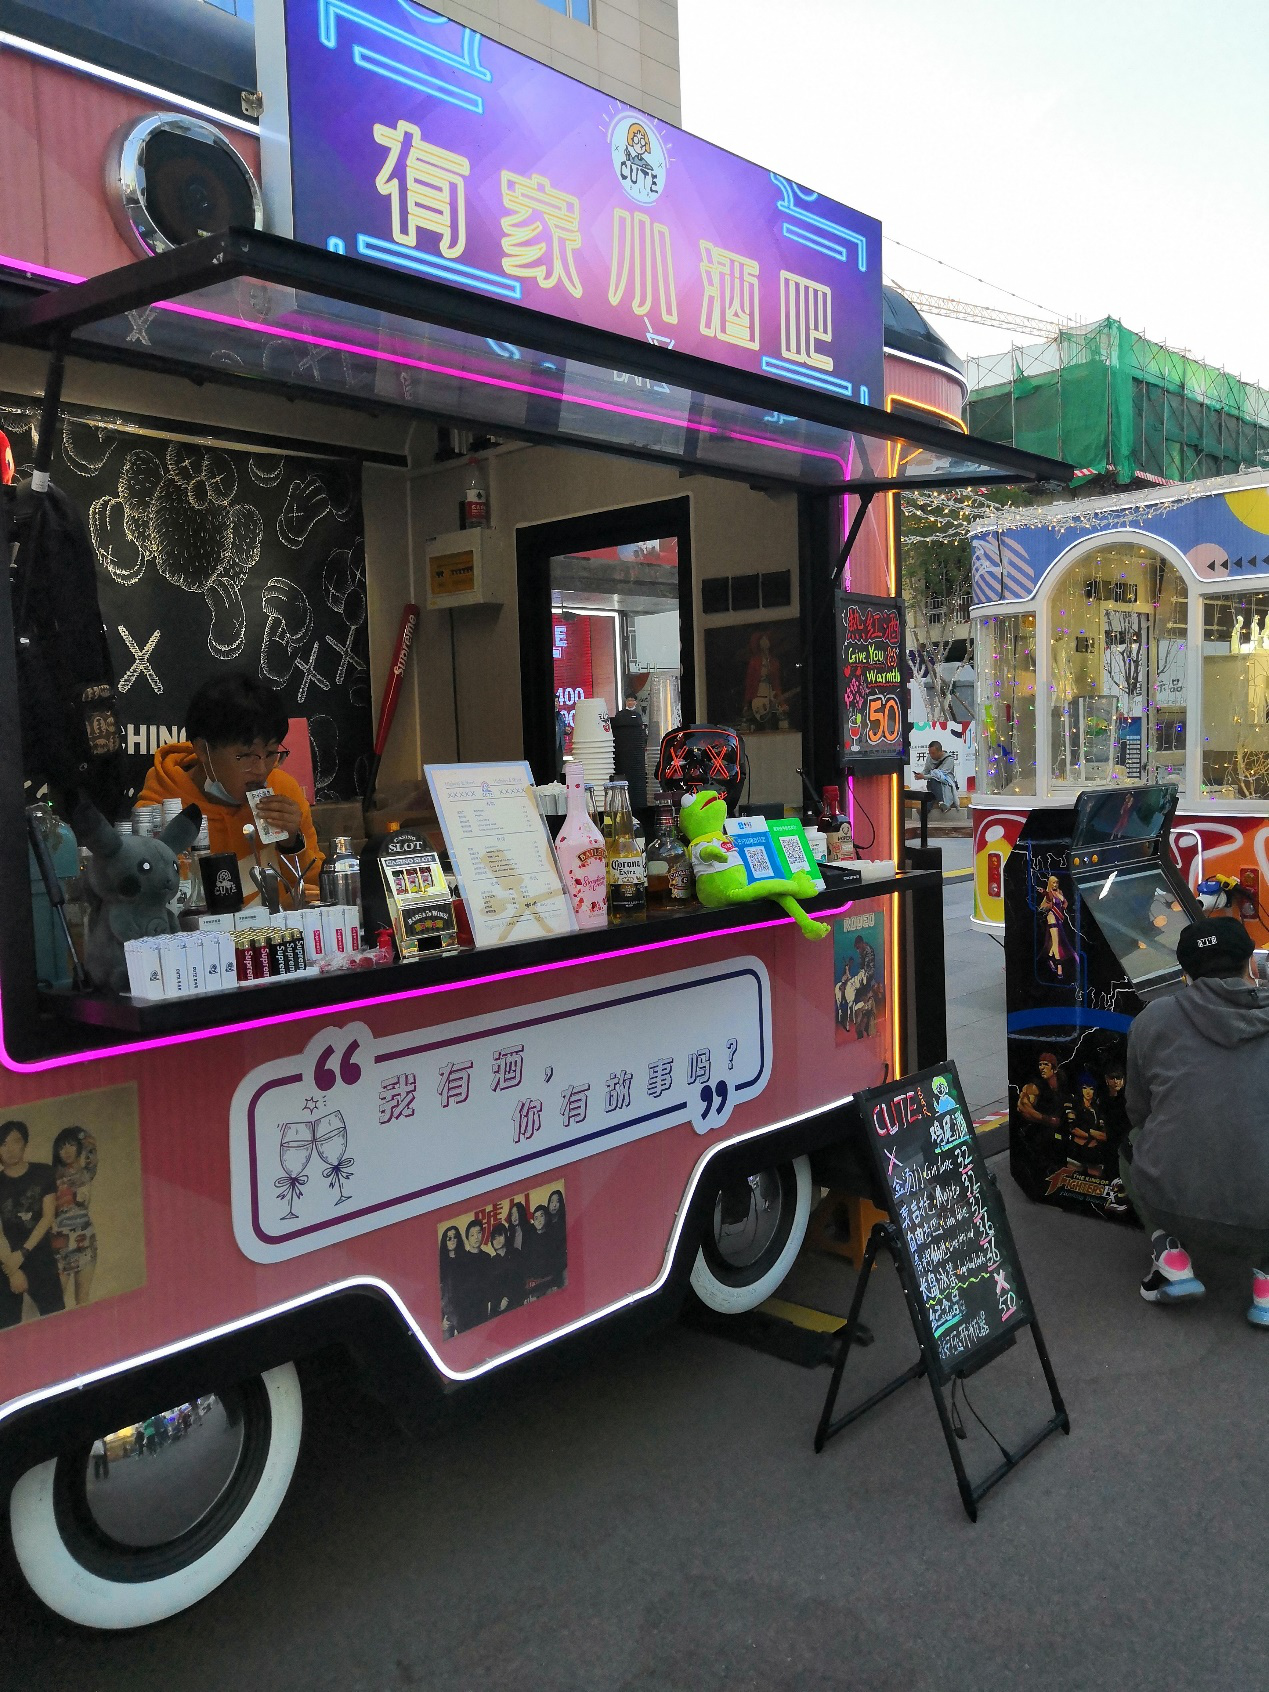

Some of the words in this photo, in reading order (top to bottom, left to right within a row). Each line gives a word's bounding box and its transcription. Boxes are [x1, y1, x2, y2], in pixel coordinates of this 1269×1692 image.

[620, 160, 659, 194] CUTE
[373, 119, 834, 372] 有家小酒吧
[847, 608, 899, 642] 热红酒
[848, 648, 867, 663] Give
[868, 644, 884, 663] You
[867, 667, 900, 684] Warmth
[868, 699, 899, 742] 50
[389, 841, 423, 853] SLOT
[394, 835, 416, 843] CASINO
[386, 858, 414, 867] CASINO
[414, 856, 433, 864] SLOT
[611, 858, 641, 870] Corona
[214, 884, 238, 895] CUTE
[843, 912, 875, 932] RODEO
[244, 951, 254, 981] Suprem
[260, 948, 270, 978] Suprem
[276, 946, 286, 975] Suprem
[286, 943, 295, 973] Suprem
[296, 940, 305, 970] Suprem
[872, 1091, 922, 1137] CUTE
[954, 1145, 973, 1172] 32
[935, 1181, 960, 1209] Mojito
[961, 1169, 981, 1196] 32
[969, 1193, 988, 1221] 32
[983, 1236, 1001, 1267] 36
[998, 1291, 1017, 1317] 50
